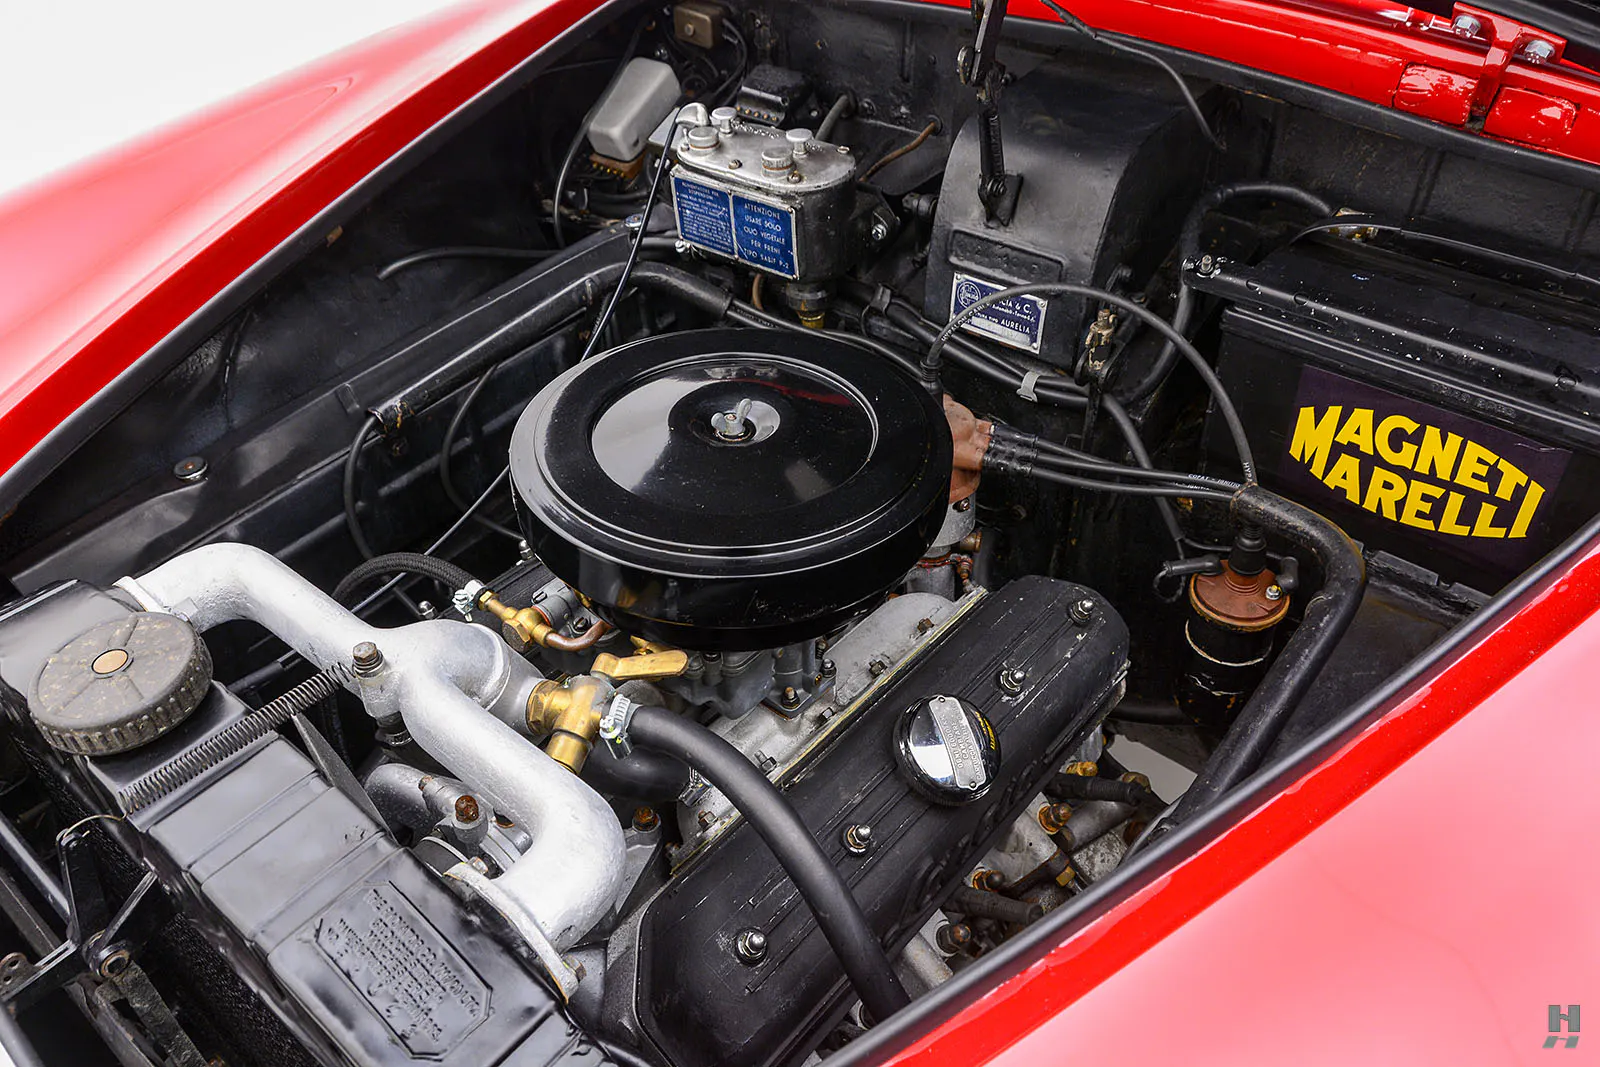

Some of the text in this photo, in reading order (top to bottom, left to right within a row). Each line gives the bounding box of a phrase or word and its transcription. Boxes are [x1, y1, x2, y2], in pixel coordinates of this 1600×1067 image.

[744, 203, 780, 219] ATTENZIONE
[744, 215, 781, 232] USARE SOLO
[761, 231, 785, 245] VEGETALE
[744, 248, 758, 258] TIPO
[751, 239, 781, 255] PER FRENI
[1001, 318, 1031, 334] AURELIA
[1289, 406, 1546, 539] MAGNETI MARELLI
